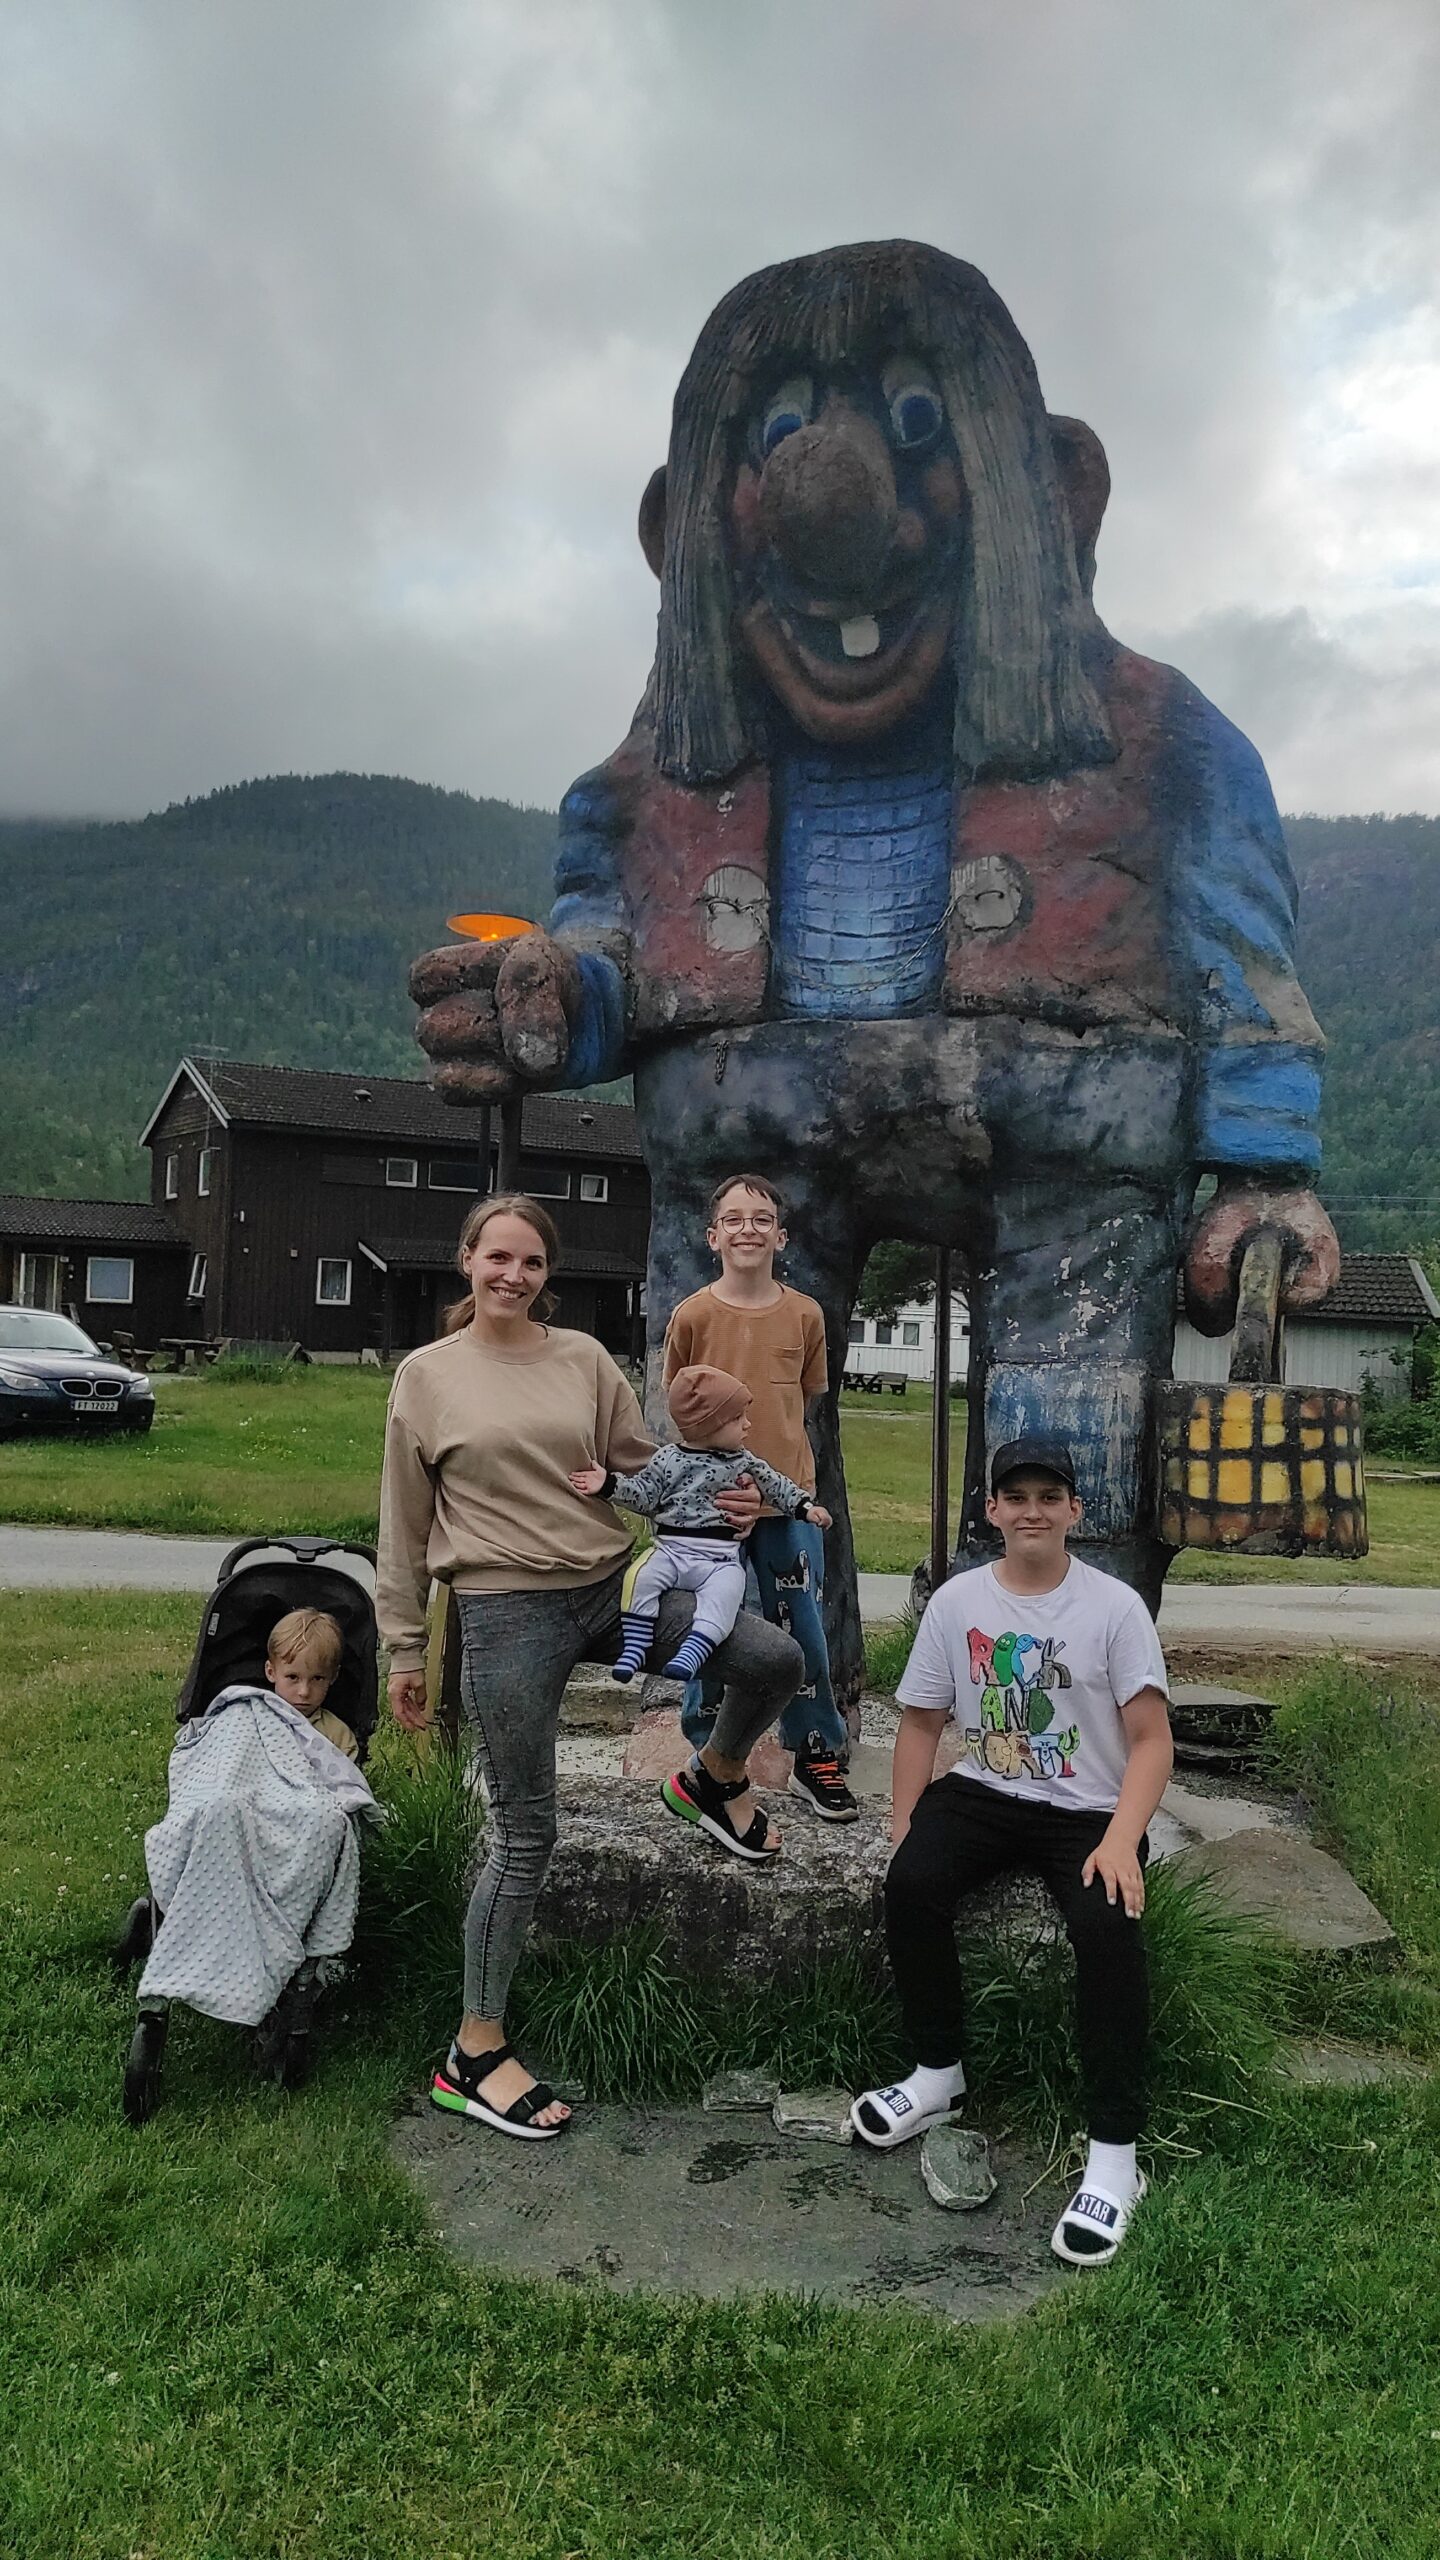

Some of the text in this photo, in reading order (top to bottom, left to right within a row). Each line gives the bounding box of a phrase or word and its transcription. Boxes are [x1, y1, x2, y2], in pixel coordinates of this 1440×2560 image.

[77, 1401, 115, 1410] FT 12022
[981, 1685, 1056, 1735] AND
[888, 2093, 910, 2114] BIG
[1078, 2194, 1111, 2223] STAR
